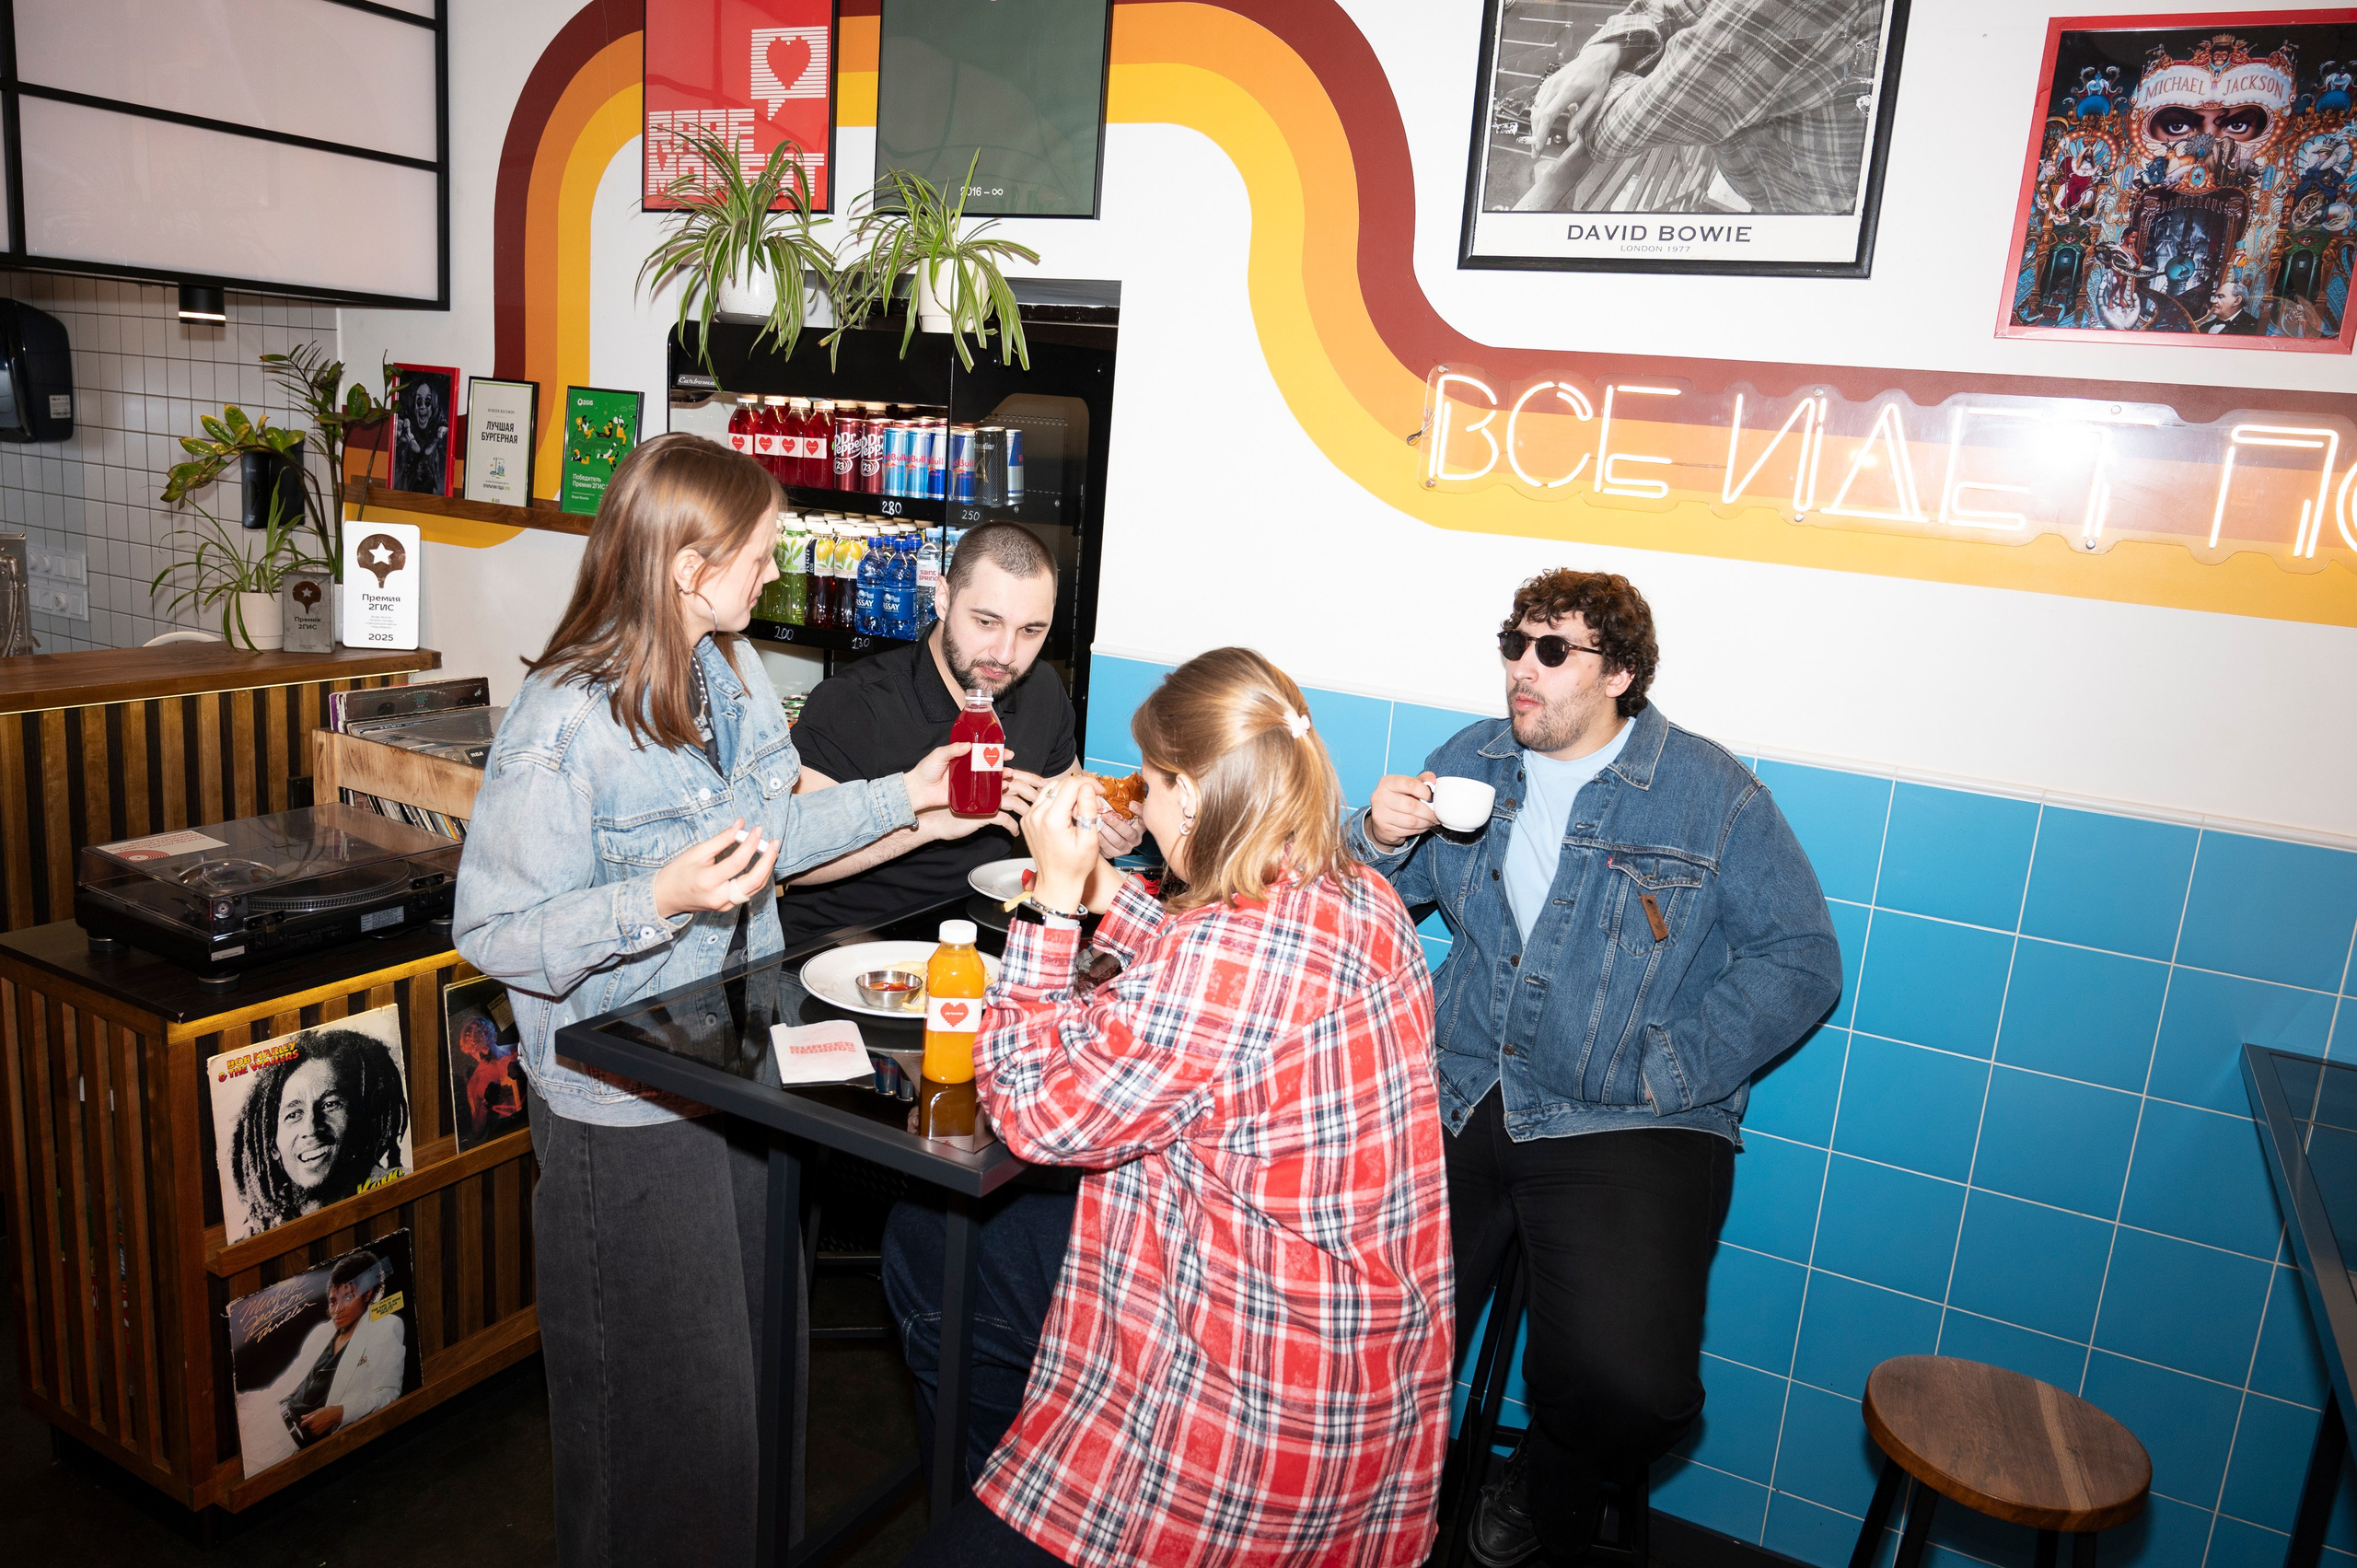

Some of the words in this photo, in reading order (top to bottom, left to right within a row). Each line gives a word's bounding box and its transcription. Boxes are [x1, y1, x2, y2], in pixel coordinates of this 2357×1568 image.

[2144, 76, 2205, 102] MICHAEL
[2223, 75, 2284, 99] JACKSON
[2161, 195, 2223, 214] DANGEROUS
[1567, 225, 1647, 241] DAVID
[1658, 226, 1752, 242] BOWIE
[679, 377, 715, 386] Carboma
[486, 421, 515, 432] ЛУЧШАЯ
[481, 432, 518, 444] БУРГЕРНАЯ
[841, 432, 856, 445] Dr
[836, 461, 844, 470] 23
[1428, 374, 1682, 499] ВСЕ
[1721, 392, 2160, 539] ИДЕТ
[2209, 424, 2357, 559] П
[573, 473, 601, 482] Победитель
[881, 500, 902, 516] 280
[961, 509, 981, 521] 250
[363, 593, 401, 602] Премия
[368, 603, 395, 611] 2ГИС
[368, 633, 394, 642] 2025
[774, 626, 794, 641] 200
[852, 637, 870, 650] 130
[226, 1054, 251, 1069] BOB
[253, 1040, 296, 1062] MARLEY
[218, 1071, 227, 1083] &
[227, 1065, 249, 1079] THE
[250, 1049, 299, 1073] WAILERS
[239, 1275, 310, 1324] Michael
[242, 1289, 314, 1343] Jackson
